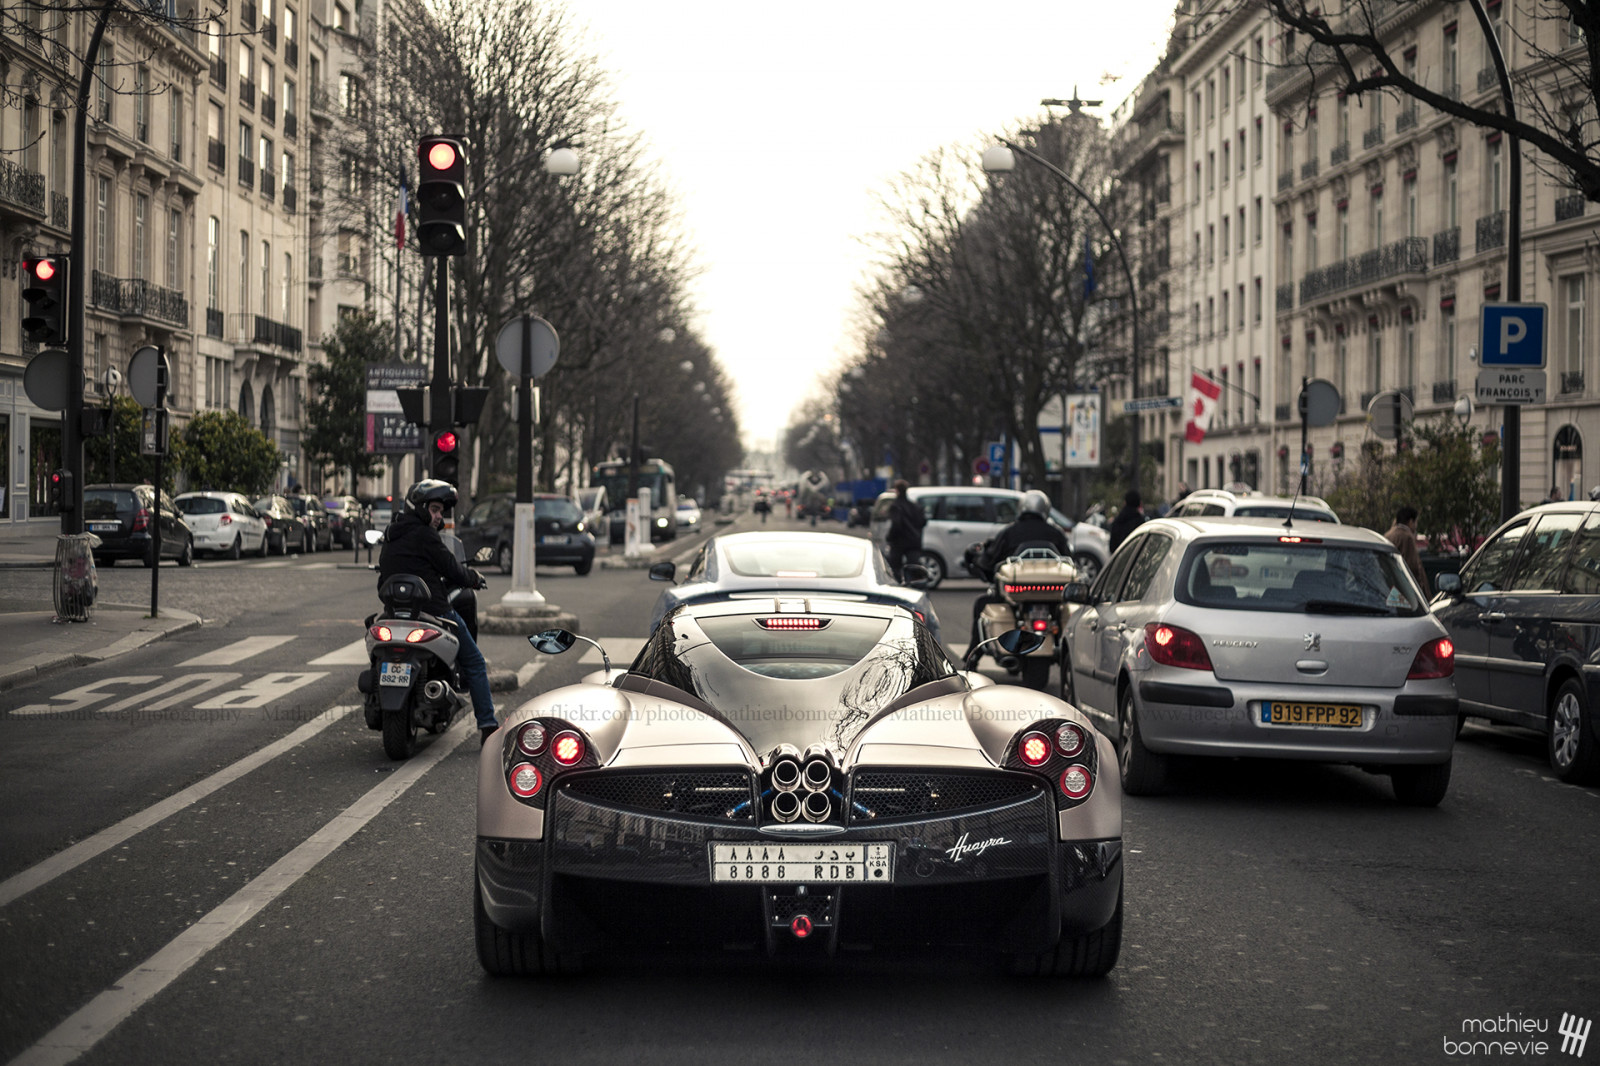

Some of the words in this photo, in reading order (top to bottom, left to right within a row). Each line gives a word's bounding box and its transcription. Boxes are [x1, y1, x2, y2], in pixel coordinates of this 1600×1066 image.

[1500, 316, 1527, 354] P
[1499, 375, 1525, 384] PARC
[1480, 387, 1531, 398] FRANÇOIS
[9, 672, 331, 715] BUS
[1273, 704, 1303, 721] 919
[1306, 706, 1336, 723] FPP
[1340, 707, 1359, 724] 92
[945, 832, 1012, 863] Huayra
